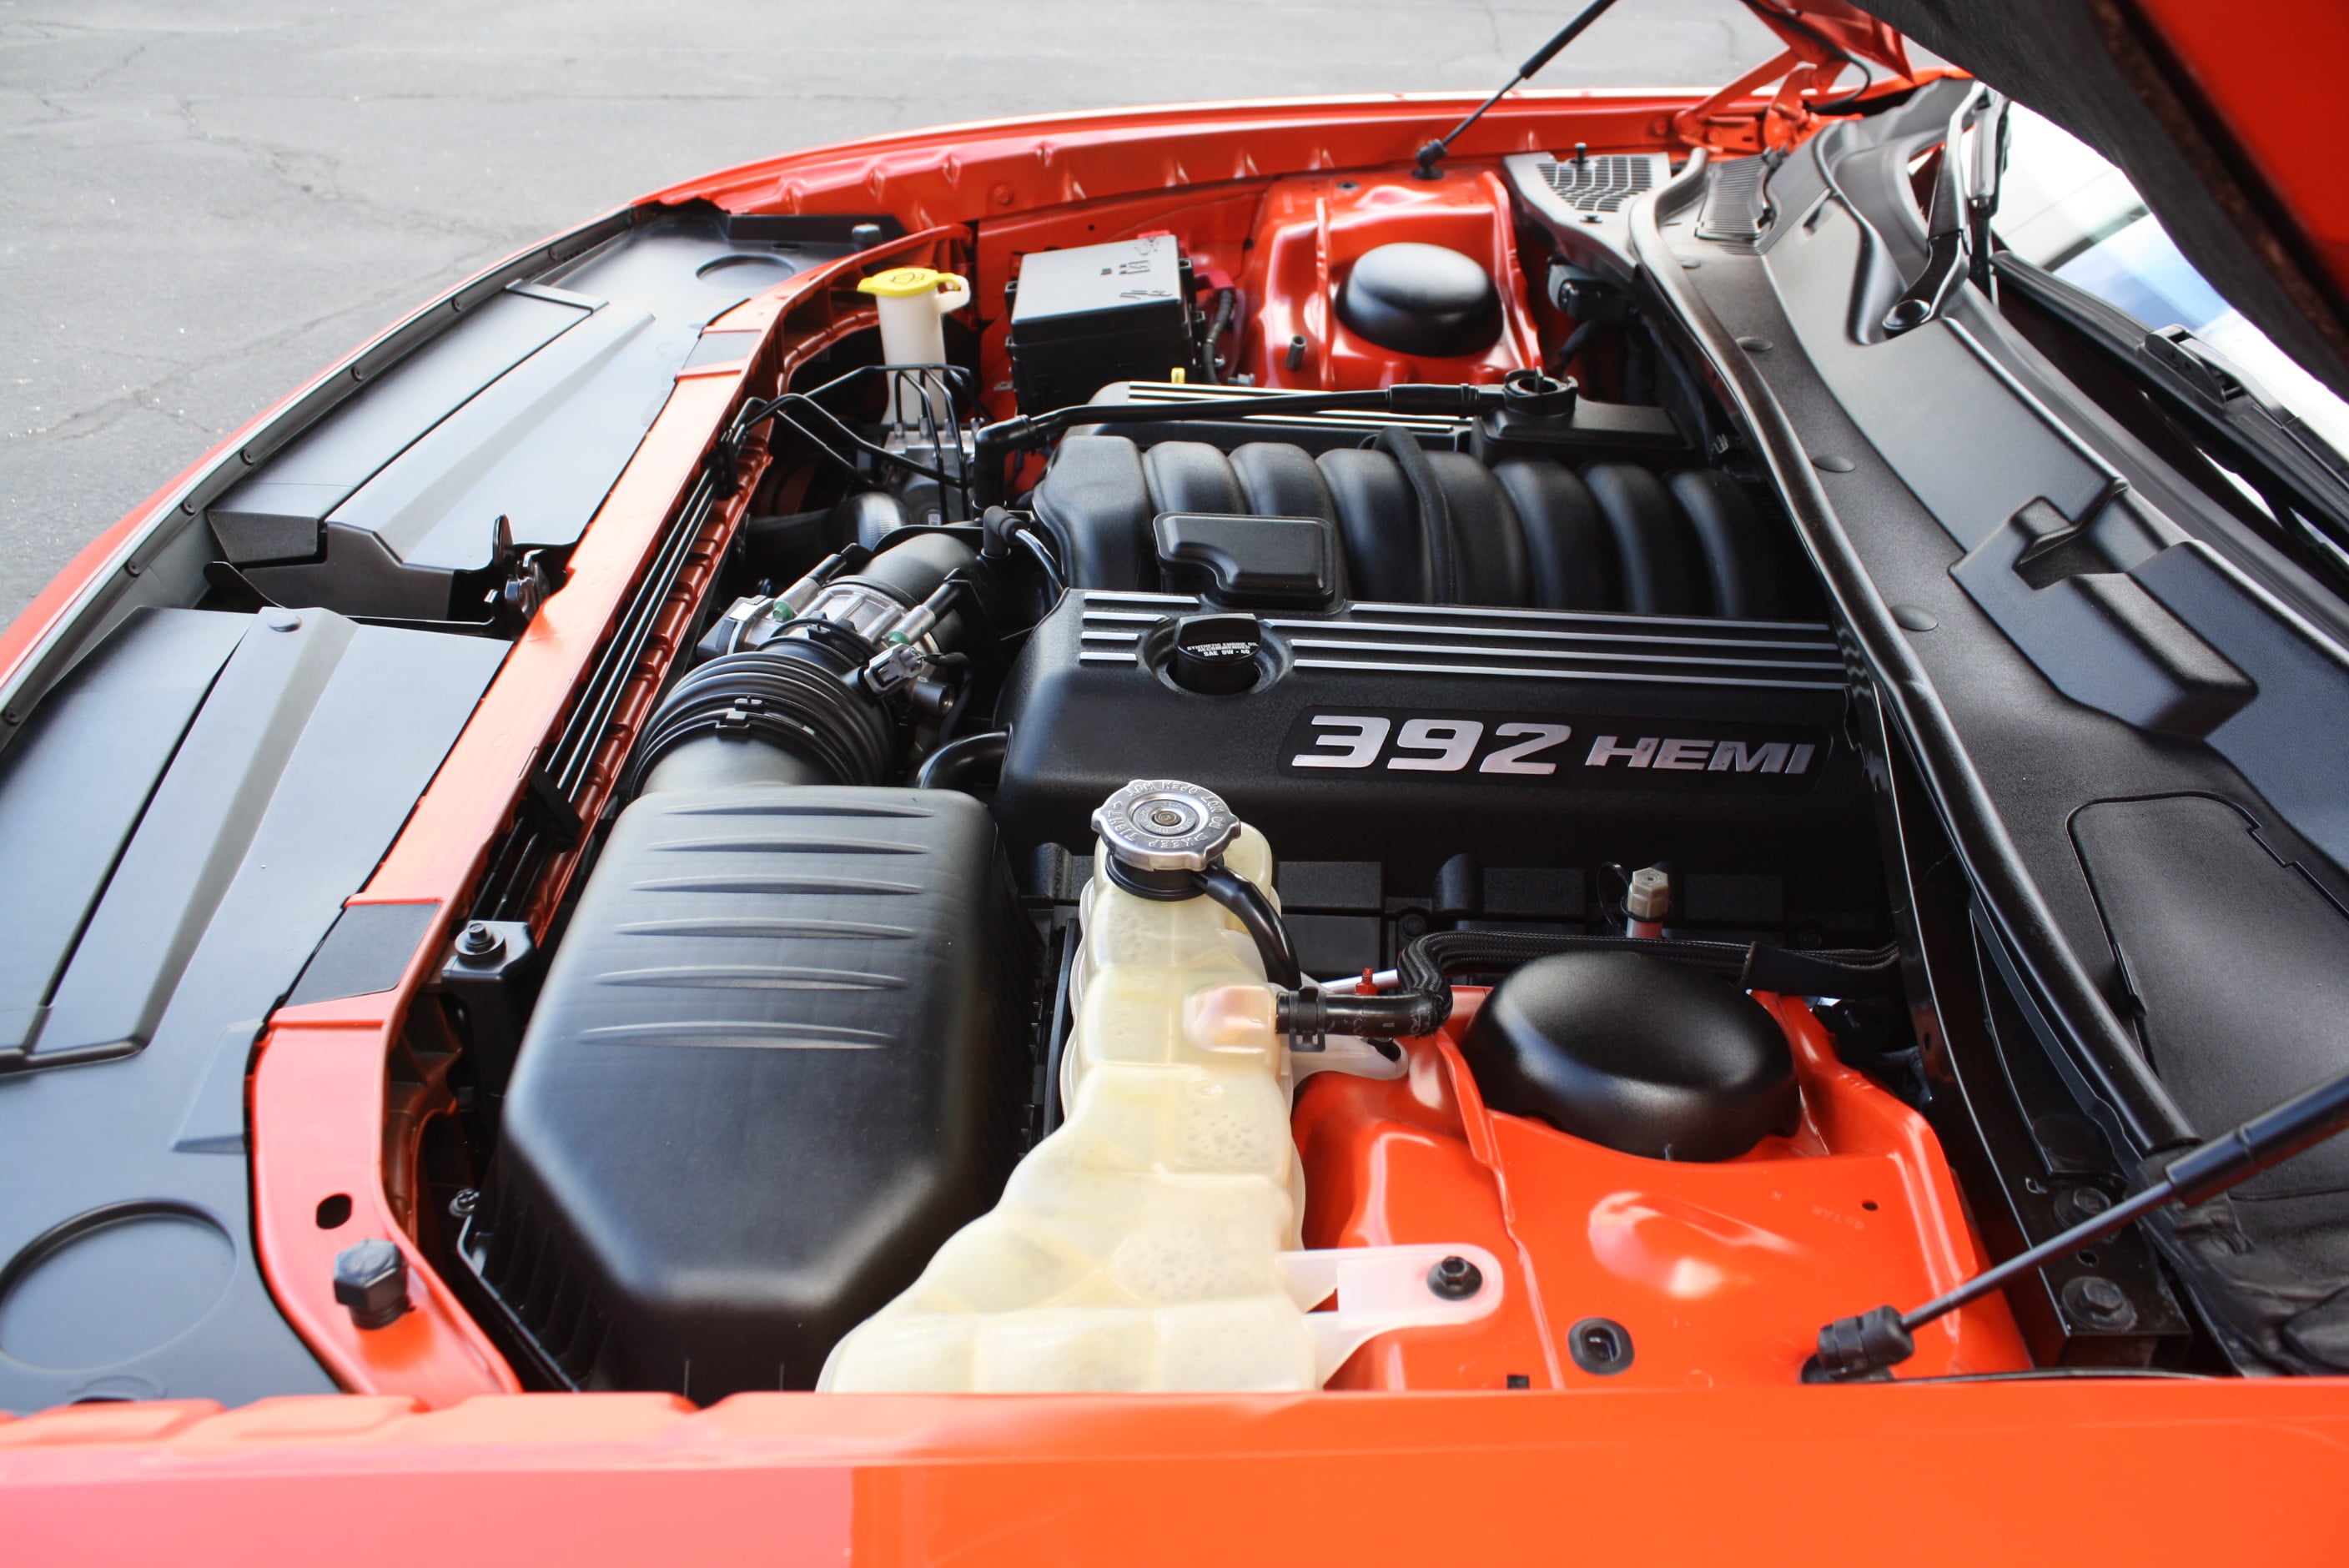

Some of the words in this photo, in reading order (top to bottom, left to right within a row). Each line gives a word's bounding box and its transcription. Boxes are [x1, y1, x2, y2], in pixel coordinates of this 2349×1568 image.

[1291, 715, 1572, 774] 392
[1585, 736, 1815, 774] HEMI
[1161, 781, 1199, 794] OPEN
[1201, 795, 1224, 814] NOT
[1105, 810, 1139, 841] TIGHT
[1147, 836, 1196, 849] KEEP
